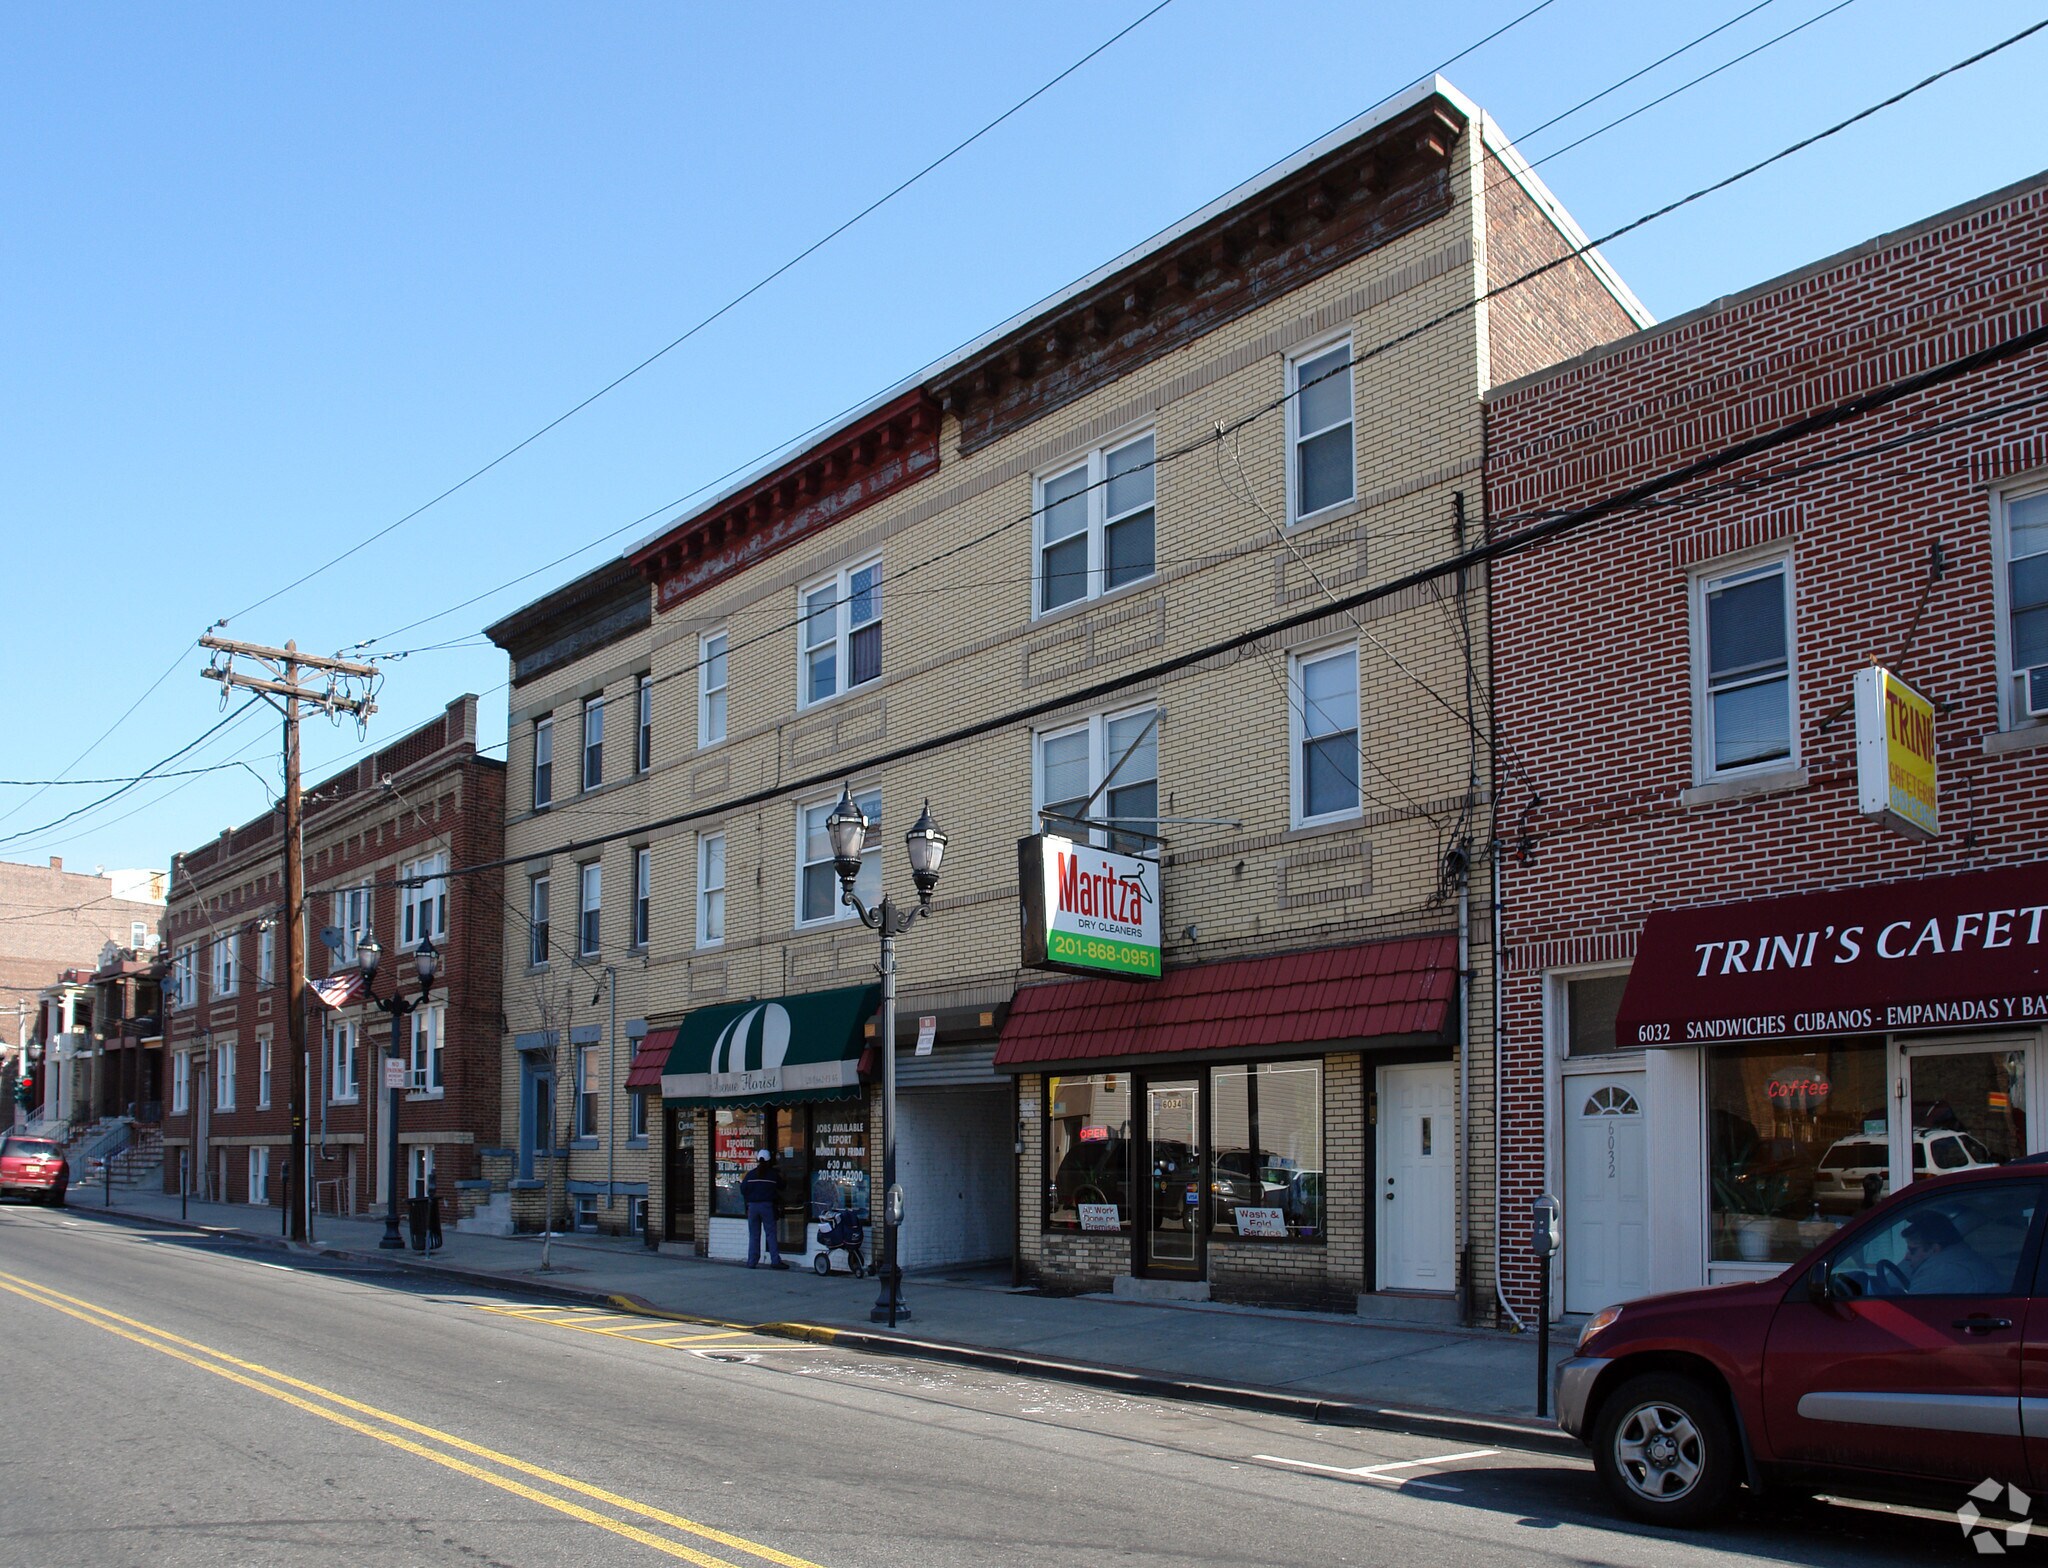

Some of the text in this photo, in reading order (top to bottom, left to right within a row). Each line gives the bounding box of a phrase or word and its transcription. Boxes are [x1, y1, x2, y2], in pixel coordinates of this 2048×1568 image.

[1889, 761, 1936, 809] CAFETERIA
[1058, 851, 1142, 925] Maritza
[1078, 918, 1143, 938] DRY CLEANERS
[1055, 936, 1155, 968] 201-868-0951
[1694, 924, 1864, 977] TRINI'S
[1638, 1023, 1671, 1042] 6032
[1686, 1014, 1786, 1039] SANDWICHES
[1793, 1008, 1872, 1032] CUBANOS
[1887, 998, 1999, 1026] EMPANADAS
[2002, 997, 2016, 1017] Y
[741, 1073, 777, 1091] Florist
[1768, 1079, 1829, 1098] Coffee
[1162, 1099, 1182, 1109] 6034
[719, 1127, 738, 1136] TRABAJO
[815, 1122, 864, 1133] JOBS AVAILABLE
[1080, 1129, 1107, 1139] OPEN
[828, 1135, 852, 1144] REPORT
[815, 1147, 865, 1157] MONDAY TO FRIDAY
[1607, 1121, 1616, 1178] 6032
[842, 1161, 852, 1170] AM
[818, 1170, 864, 1182] 201-854-0200
[1082, 1206, 1115, 1214] All Work
[1240, 1210, 1280, 1219] Wash &
[1085, 1223, 1120, 1231] Premises
[1250, 1219, 1272, 1227] Fold
[1243, 1227, 1282, 1236] Service
